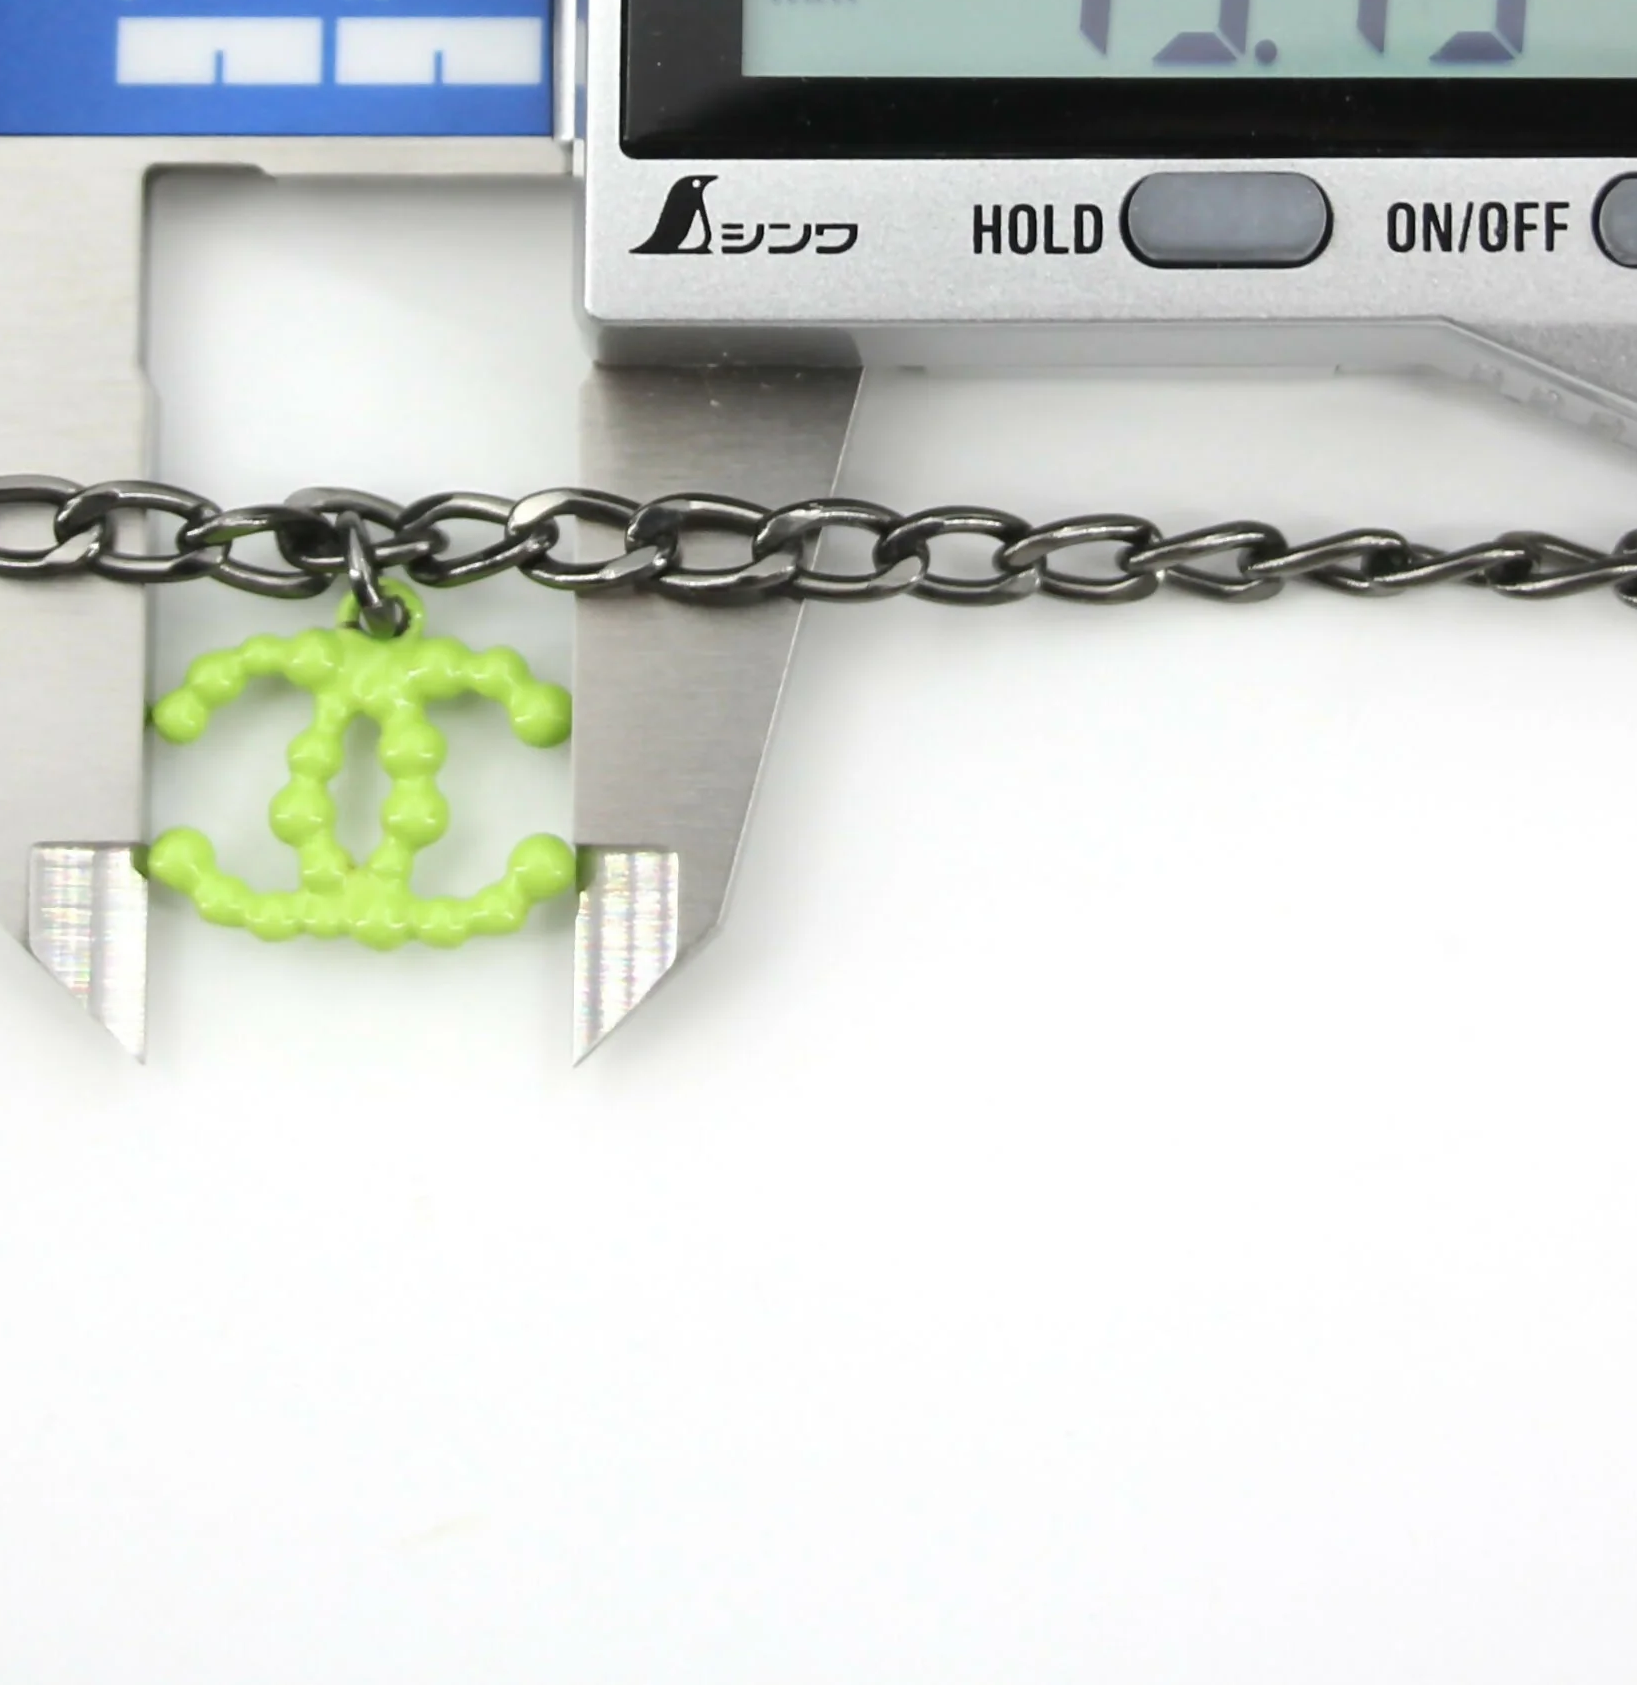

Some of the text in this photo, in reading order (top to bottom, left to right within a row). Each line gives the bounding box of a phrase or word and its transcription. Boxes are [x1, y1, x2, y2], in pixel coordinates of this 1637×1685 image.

[720, 223, 859, 255] シンワ
[972, 203, 1104, 255] HOLD
[1386, 200, 1571, 253] ON/OFF
